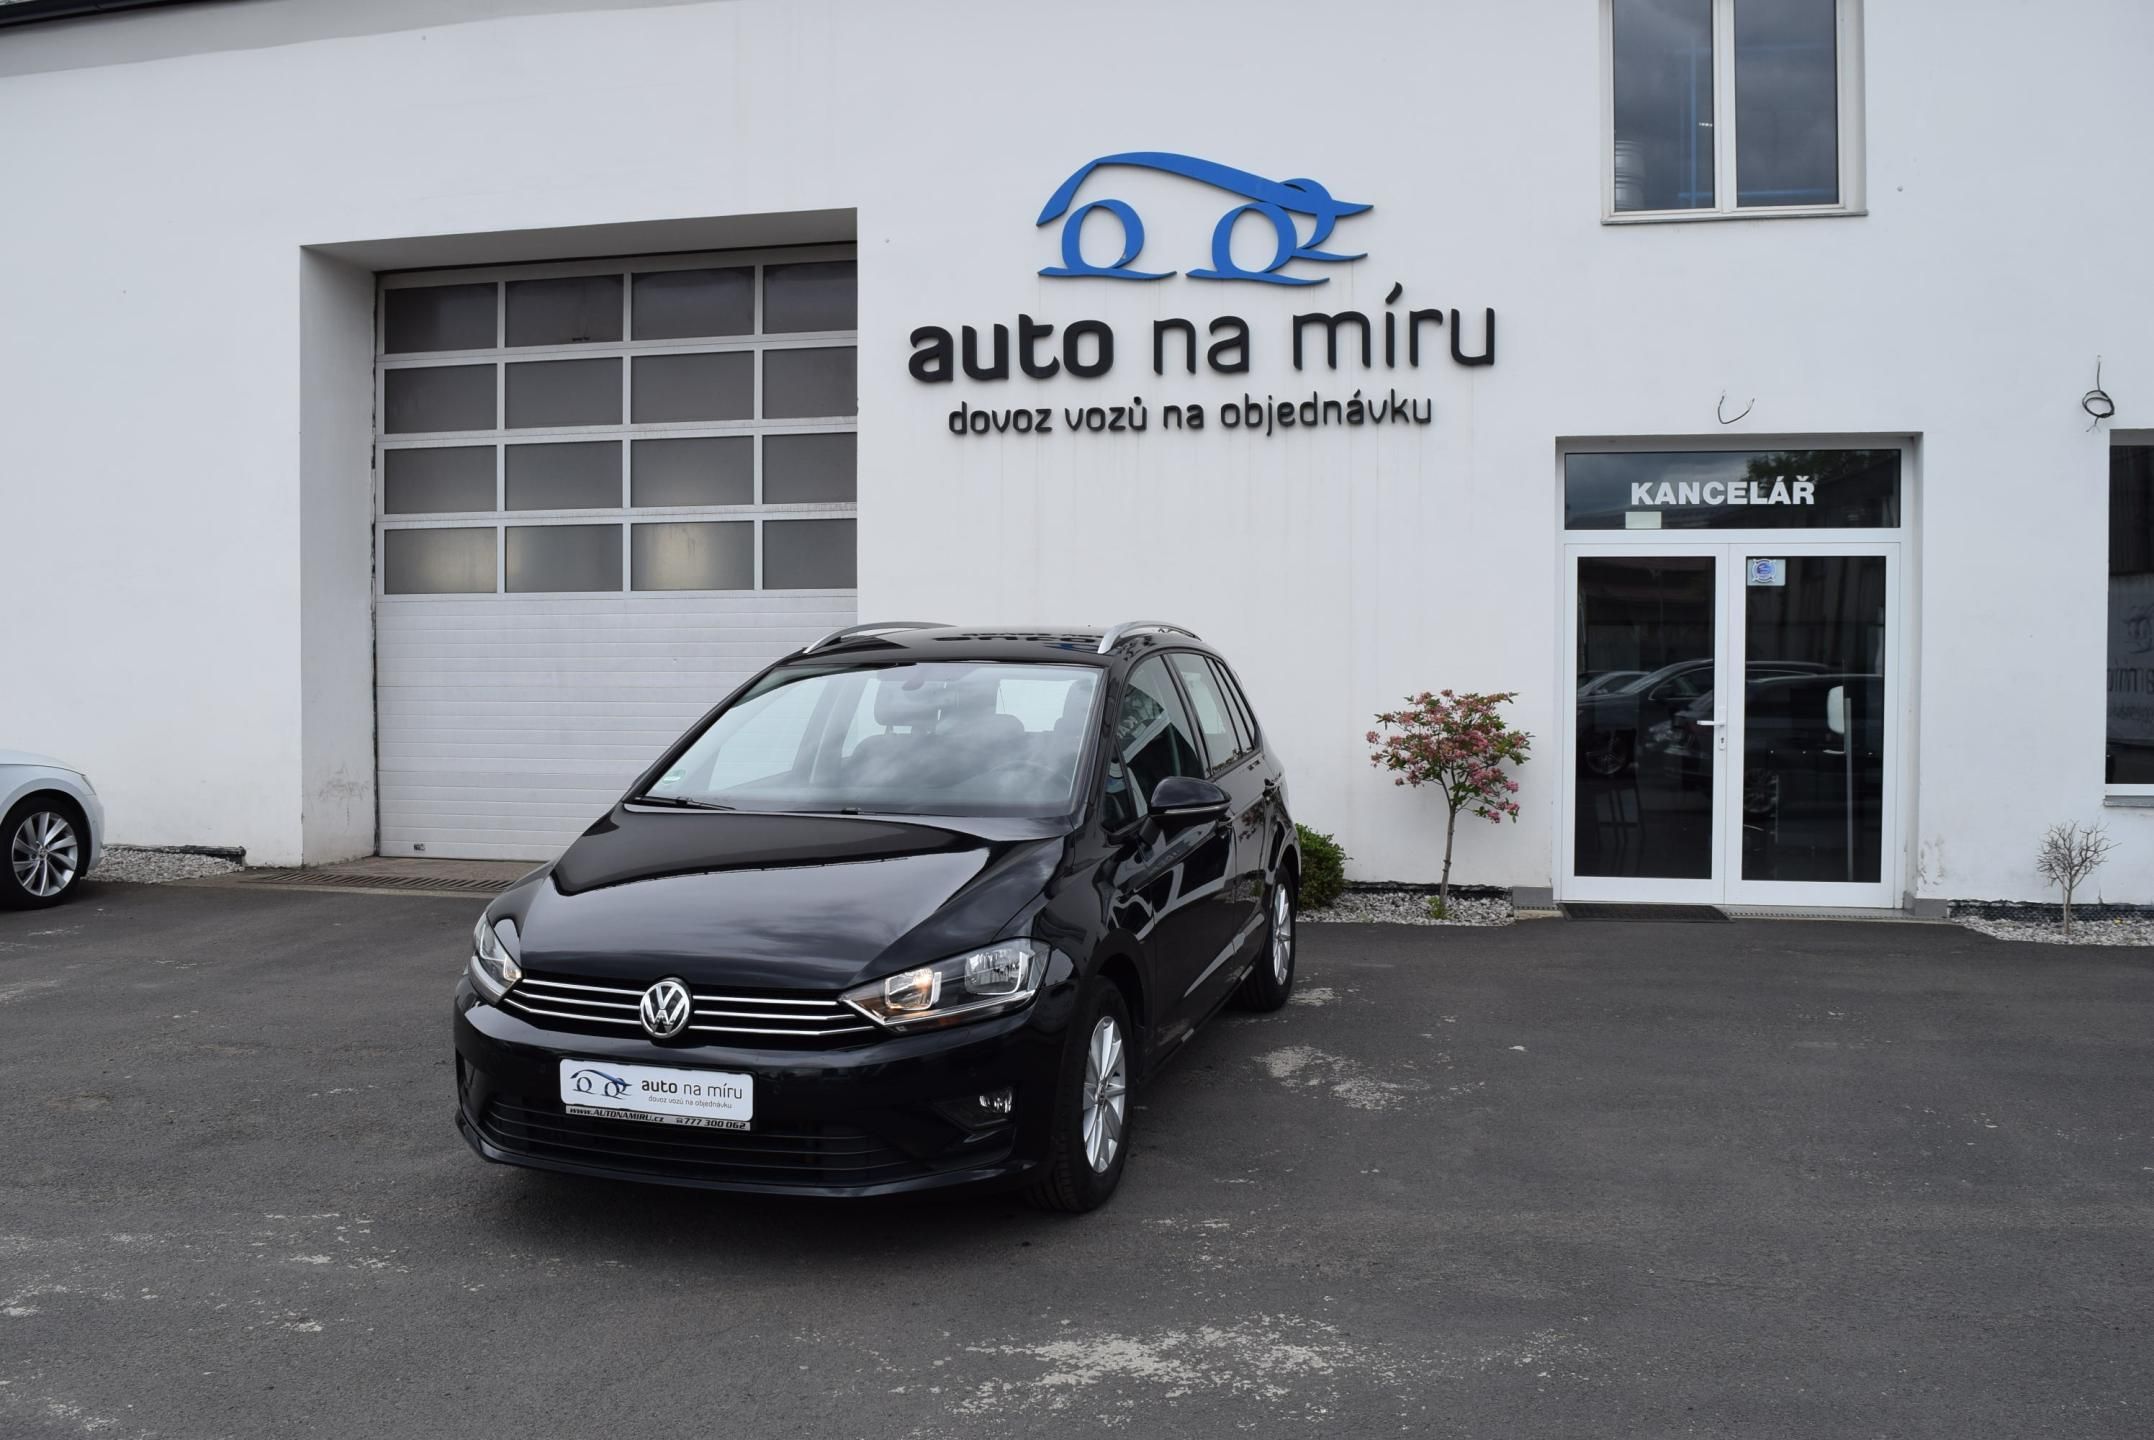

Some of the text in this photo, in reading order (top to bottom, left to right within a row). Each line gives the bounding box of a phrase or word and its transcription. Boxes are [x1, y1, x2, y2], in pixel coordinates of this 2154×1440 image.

[908, 281, 1496, 383] auto na míru
[948, 388, 1432, 437] dovoz vozů na objednávku
[1631, 475, 1815, 505] KANCELÁŘ
[641, 1079, 743, 1100] auto na míru
[648, 1095, 668, 1104] dovoz
[694, 1099, 733, 1109] objednávku
[704, 1119, 724, 1128] 300
[725, 1121, 747, 1130] 062
